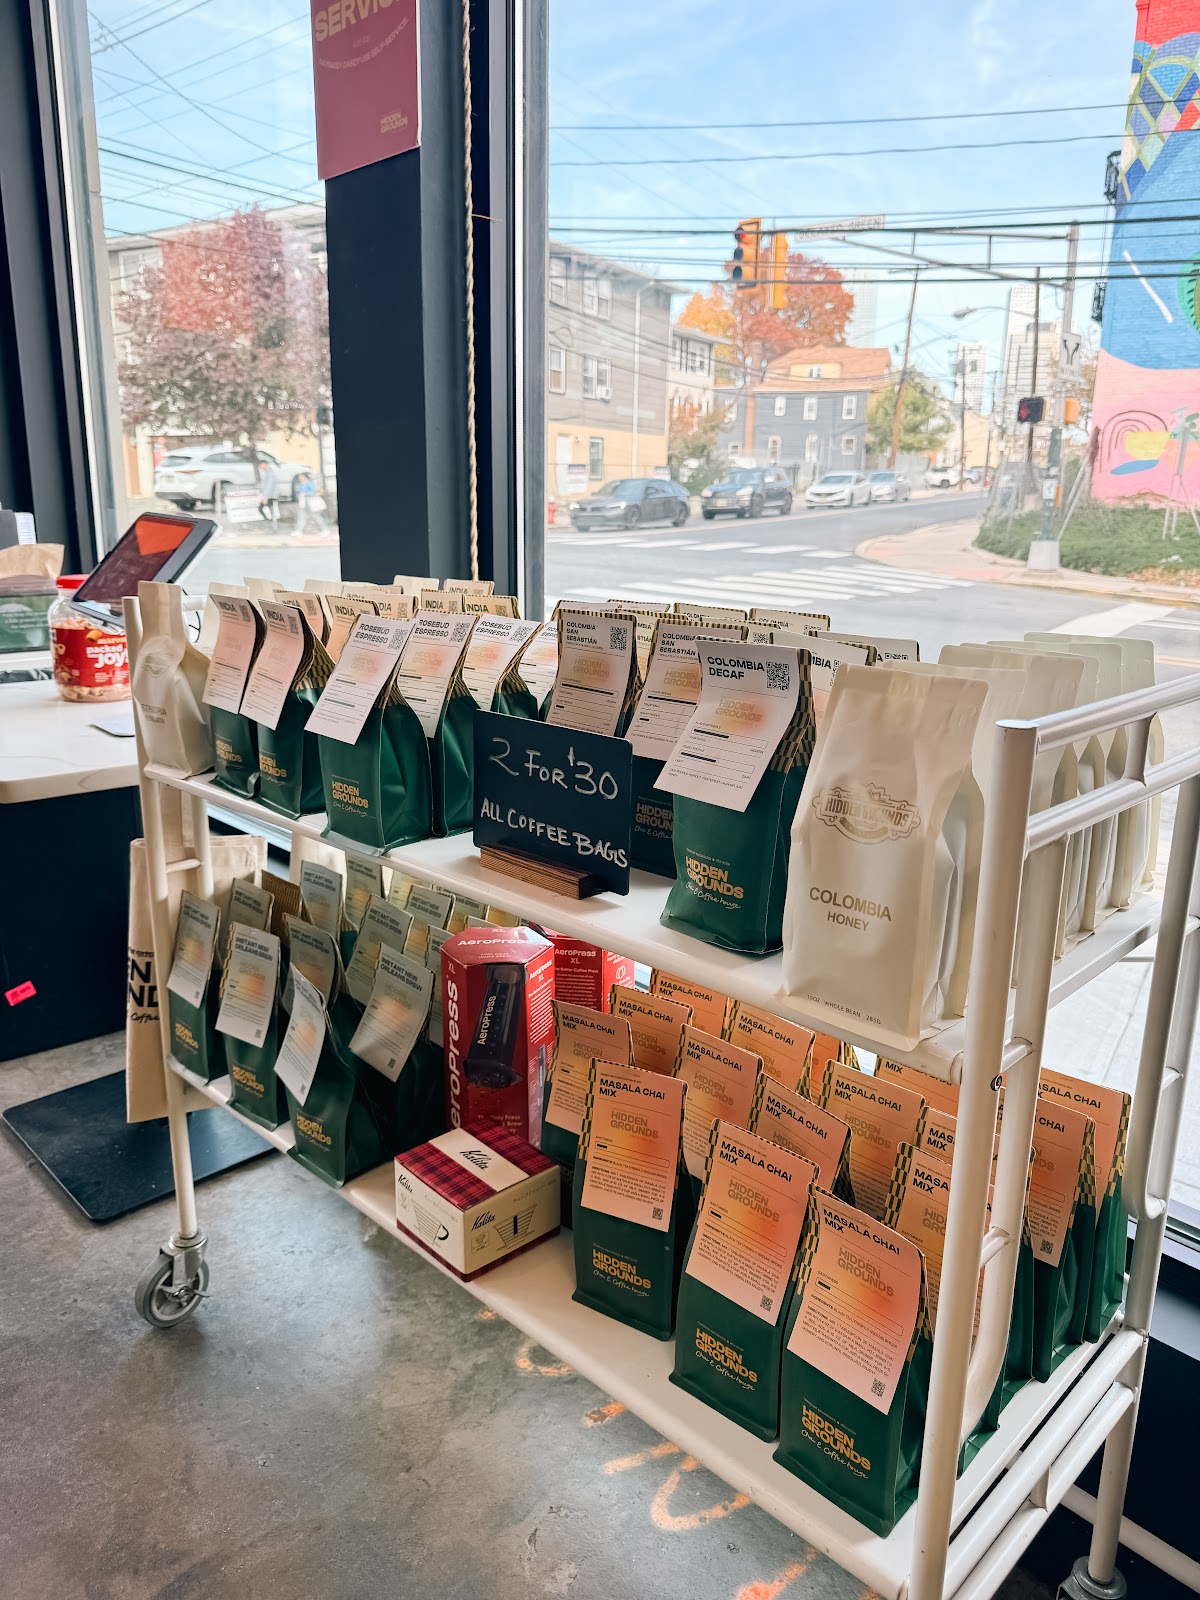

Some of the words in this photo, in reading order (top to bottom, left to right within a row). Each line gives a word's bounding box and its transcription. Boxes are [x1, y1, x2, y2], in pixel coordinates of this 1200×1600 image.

[218, 601, 237, 613] INDIA
[335, 604, 356, 618] INDIA
[425, 599, 444, 610] INDIA
[466, 603, 489, 613] INDIA
[265, 609, 286, 624] INDIA
[418, 619, 450, 630] ROSEBUD
[359, 622, 391, 636] ROSEBUD
[414, 628, 449, 638] ESPRESSO
[475, 627, 510, 638] ESPRESSO
[480, 620, 512, 631] ROSEBUD
[566, 621, 596, 631] COLOMBIA
[354, 632, 389, 645] ESPRESSO
[566, 635, 597, 645] SEBASTIÁN
[660, 646, 696, 656] SEBASTIÁN
[573, 664, 610, 678] GROUNDS
[574, 657, 602, 669] HIDDEN
[707, 656, 765, 671] COLOMBIA
[665, 669, 698, 681] HIDDEN
[709, 667, 745, 681] DECAF
[663, 677, 700, 689] GROUND
[715, 706, 763, 723] GROUNDS
[718, 699, 756, 713] HIDDEN
[488, 736, 519, 776] 2
[331, 780, 360, 797] HIDDEN
[331, 789, 369, 809] GROUNDS
[480, 797, 504, 823] ALL
[507, 808, 571, 847] COFFEE
[572, 831, 628, 869] BAGS
[685, 856, 729, 882] HIDDEN
[687, 867, 744, 899] GROUNDS
[809, 886, 893, 922] COLOMBIA
[827, 911, 870, 932] HONEY
[554, 948, 598, 957] AeroPress
[380, 964, 405, 983] ORLEANS
[405, 978, 423, 992] BREW
[381, 957, 406, 974] INSTANT
[405, 970, 419, 982] NEW
[659, 987, 673, 997] MIX
[660, 980, 693, 998] MASALA
[692, 990, 713, 1002] CHAI
[131, 1012, 160, 1023] Coffee
[618, 1007, 633, 1018] MIX
[619, 1000, 654, 1018] MASALA
[655, 1011, 673, 1023] CHAI
[845, 1007, 861, 1018] BEAN
[477, 995, 497, 1046] AeroPress
[562, 1013, 596, 1031] MASALA
[596, 1022, 615, 1036] CHAI
[562, 1020, 577, 1031] MIX
[738, 1022, 753, 1035] MIX
[740, 1015, 774, 1040] MASALA
[773, 1031, 794, 1046] CHAI
[447, 979, 462, 1129] eroPress
[573, 1041, 602, 1057] HIDDEN
[686, 1049, 702, 1062] MIX
[688, 1040, 721, 1064] MASALA
[722, 1056, 742, 1072] CHAI
[885, 1061, 904, 1074] MIX
[600, 1078, 641, 1097] MASALA
[642, 1087, 665, 1100] CHAI
[694, 1072, 726, 1093] HIDDEN
[599, 1087, 617, 1098] MIX
[692, 1080, 734, 1106] GROUNDS
[834, 1088, 852, 1102] MIX
[836, 1079, 877, 1102] MASALA
[877, 1096, 902, 1112] CHAI
[1073, 1094, 1101, 1109] CHAI
[611, 1110, 648, 1128] HIDDEN
[765, 1105, 783, 1120] MIX
[767, 1095, 805, 1123] MASALA
[805, 1119, 828, 1140] CHAI
[610, 1120, 659, 1139] GROUNDS
[1039, 1117, 1065, 1133] CHAI
[927, 1137, 948, 1152] MIX
[459, 1150, 492, 1171] Kalita
[719, 1151, 739, 1166] MIX
[720, 1140, 765, 1171] MASALA
[766, 1165, 793, 1183] CHAI
[398, 1174, 413, 1193] Kalita
[912, 1177, 935, 1195] MIX
[914, 1168, 949, 1191] MASA
[728, 1178, 769, 1205] HIDDEN
[727, 1188, 780, 1224] GROUNDS
[471, 1210, 496, 1232] Kalita
[824, 1217, 845, 1234] MIX
[823, 1208, 871, 1241] MASALA
[872, 1234, 901, 1256] CHAI
[592, 1249, 637, 1275] HIDDEN
[838, 1246, 882, 1280] HIDDEN
[592, 1258, 651, 1289] GROUNDS
[837, 1257, 894, 1298] GROUNDS
[696, 1328, 743, 1363] HIDDEN
[695, 1338, 758, 1384] GROUNDS
[802, 1405, 855, 1449] HIDDEN
[802, 1416, 871, 1470] GROUNDS
[823, 1447, 847, 1465] Coffee
